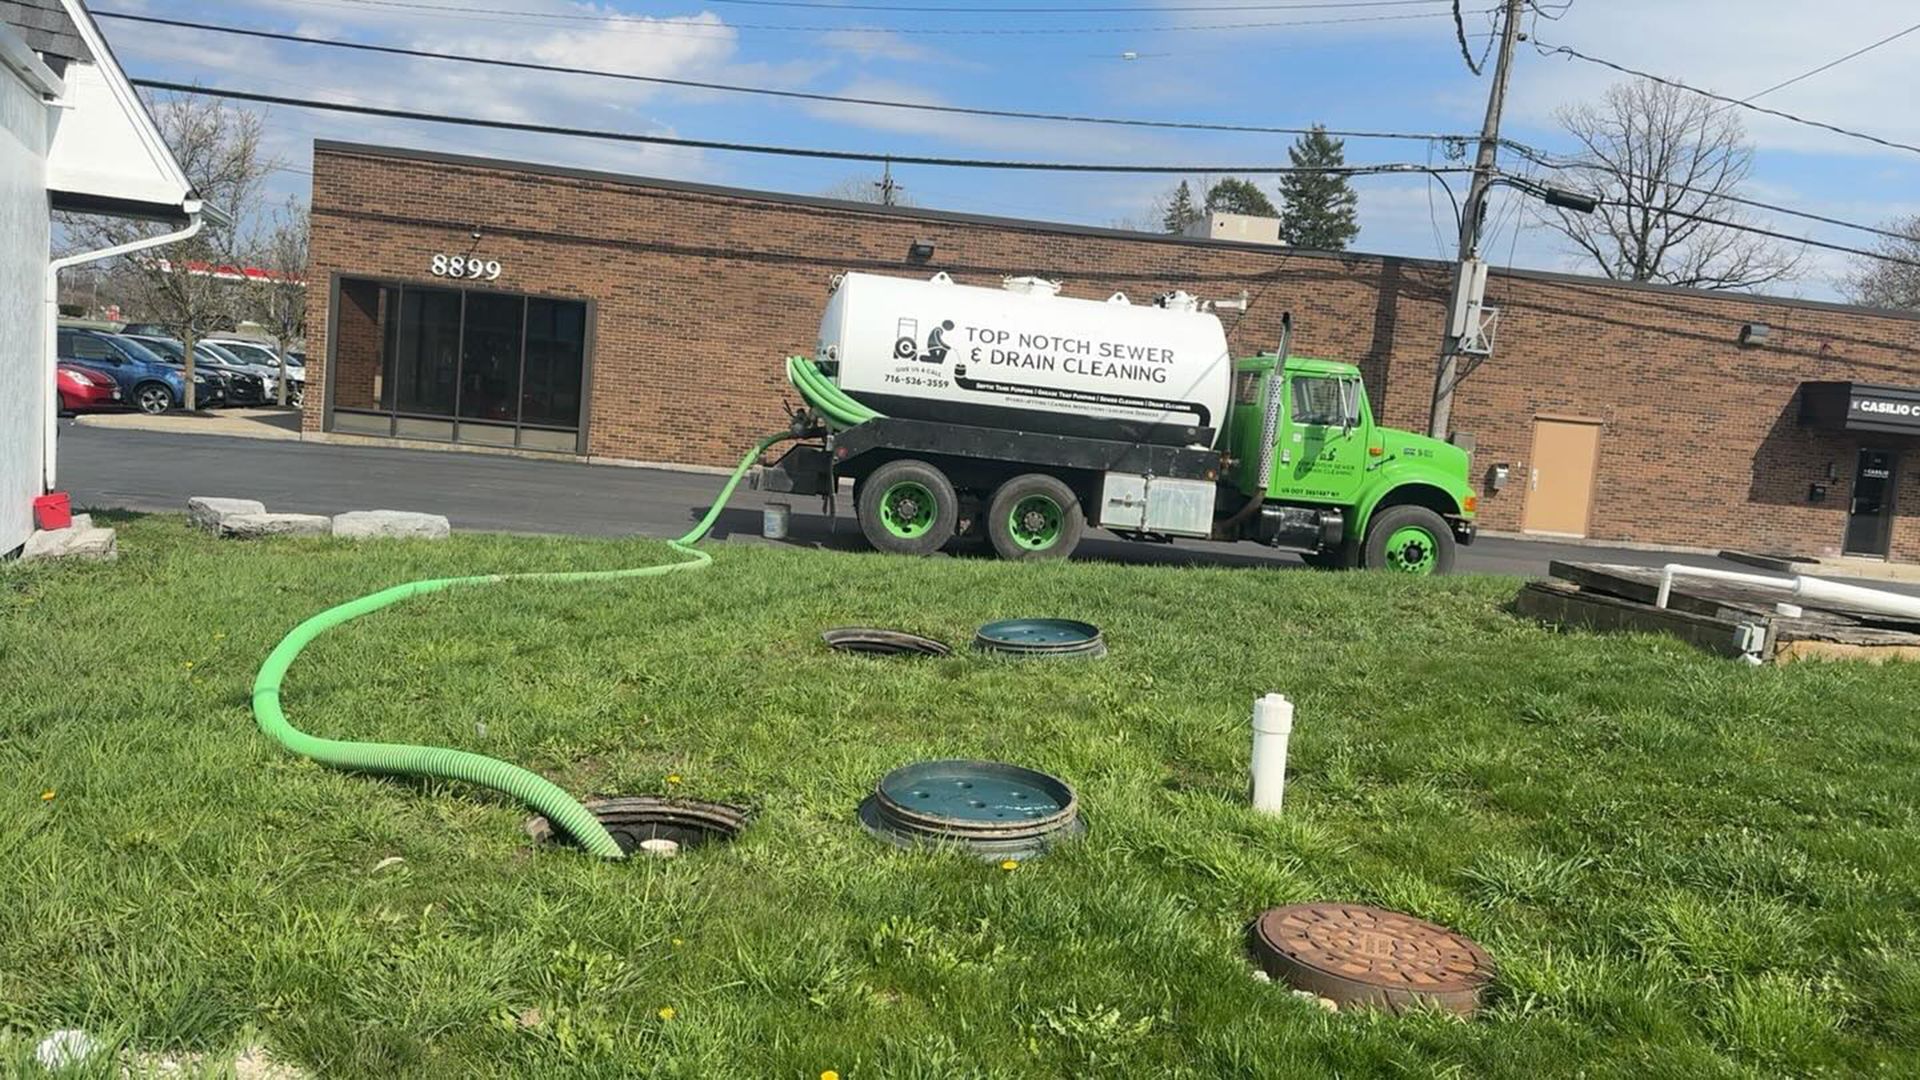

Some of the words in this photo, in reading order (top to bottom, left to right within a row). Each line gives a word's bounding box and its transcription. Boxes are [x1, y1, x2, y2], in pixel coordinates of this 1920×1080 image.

[431, 254, 501, 280] 8899
[965, 327, 1010, 345] TOP
[1018, 333, 1090, 355] NOTCH
[1099, 342, 1174, 364] SEWER
[970, 347, 982, 363] &
[991, 349, 1055, 371] DRAIN
[1063, 357, 1167, 383] CLEANING
[1861, 401, 1910, 416] CASILIO
